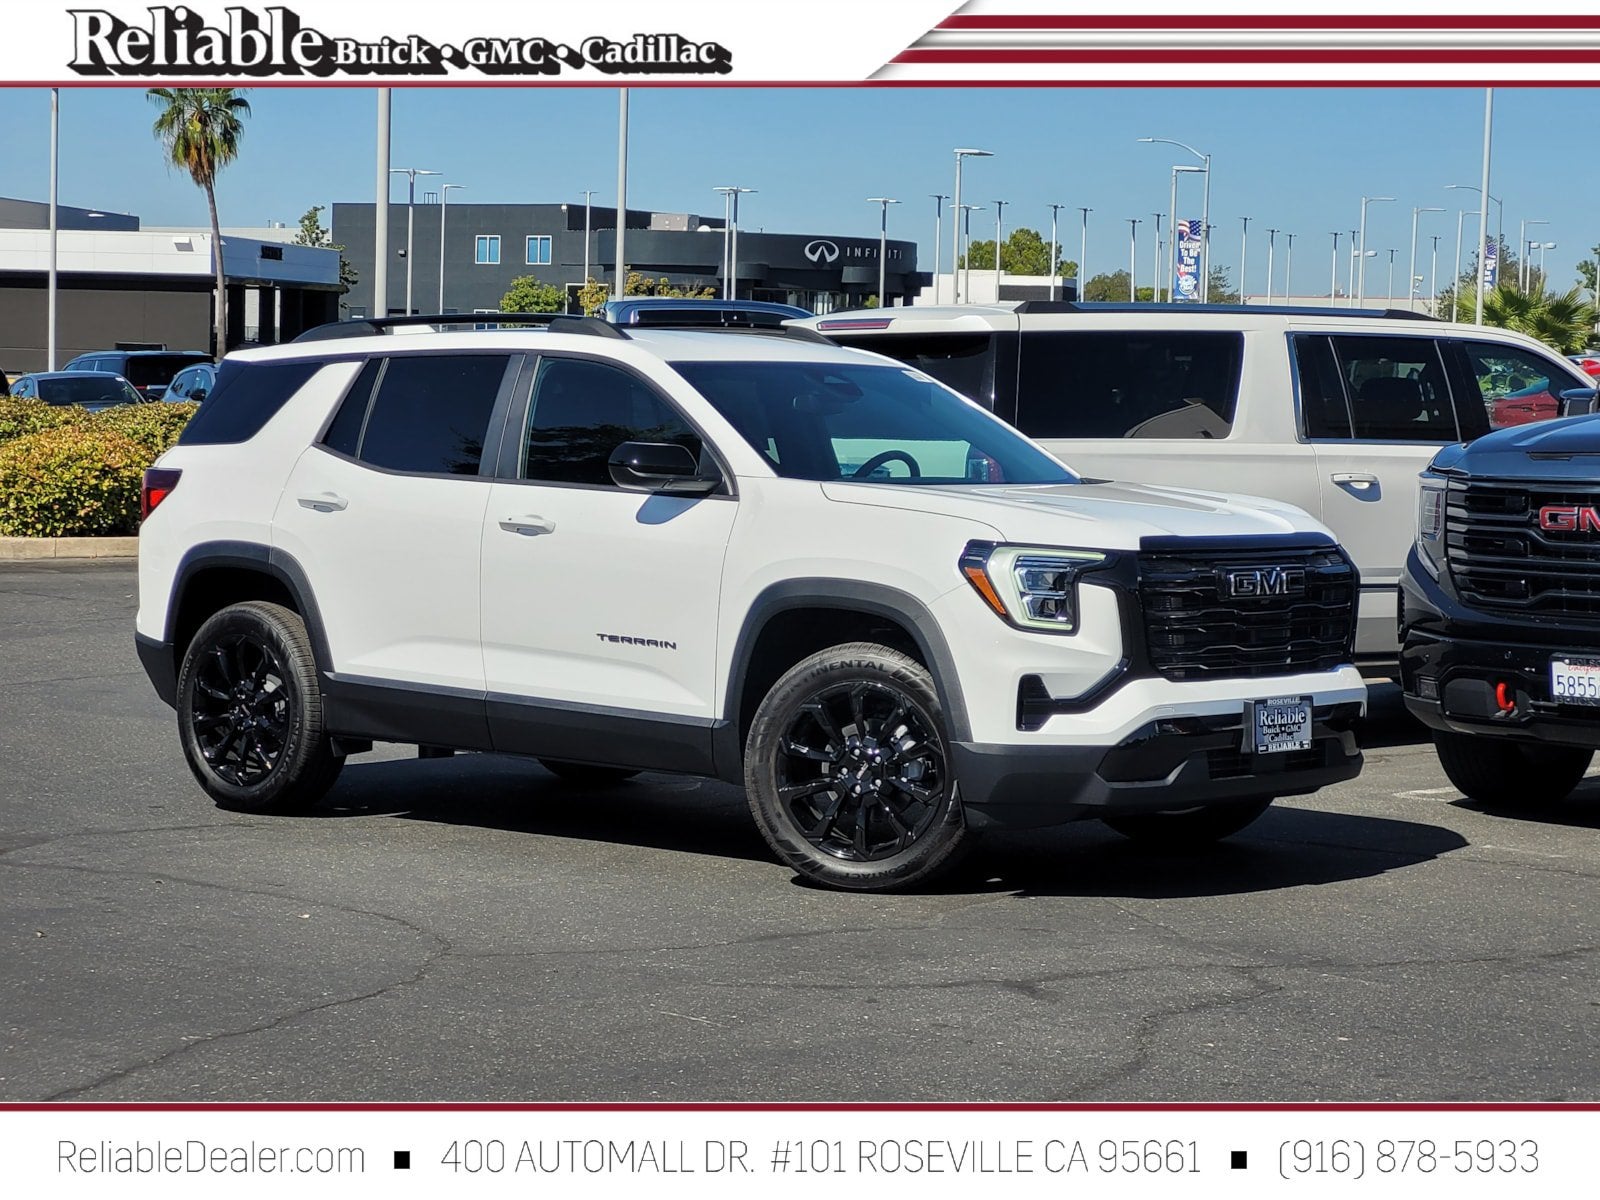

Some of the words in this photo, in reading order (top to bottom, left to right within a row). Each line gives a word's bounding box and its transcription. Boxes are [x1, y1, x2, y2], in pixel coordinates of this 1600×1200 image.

[1179, 240, 1201, 249] Driven
[846, 246, 903, 260] INFIITI
[1181, 248, 1189, 257] To
[1189, 248, 1199, 257] Be
[1183, 256, 1196, 265] The
[1180, 264, 1197, 273] Best!
[1230, 569, 1305, 596] GMC
[596, 633, 677, 650] TERRAIN
[1556, 674, 1600, 698] 5855
[1266, 697, 1301, 707] ROSEVILLE
[1259, 706, 1306, 727] Reliable
[1262, 724, 1281, 735] Buick
[1285, 723, 1301, 733] GMC
[1267, 732, 1296, 743] Cadillac
[1267, 740, 1302, 752] RELIABLE
